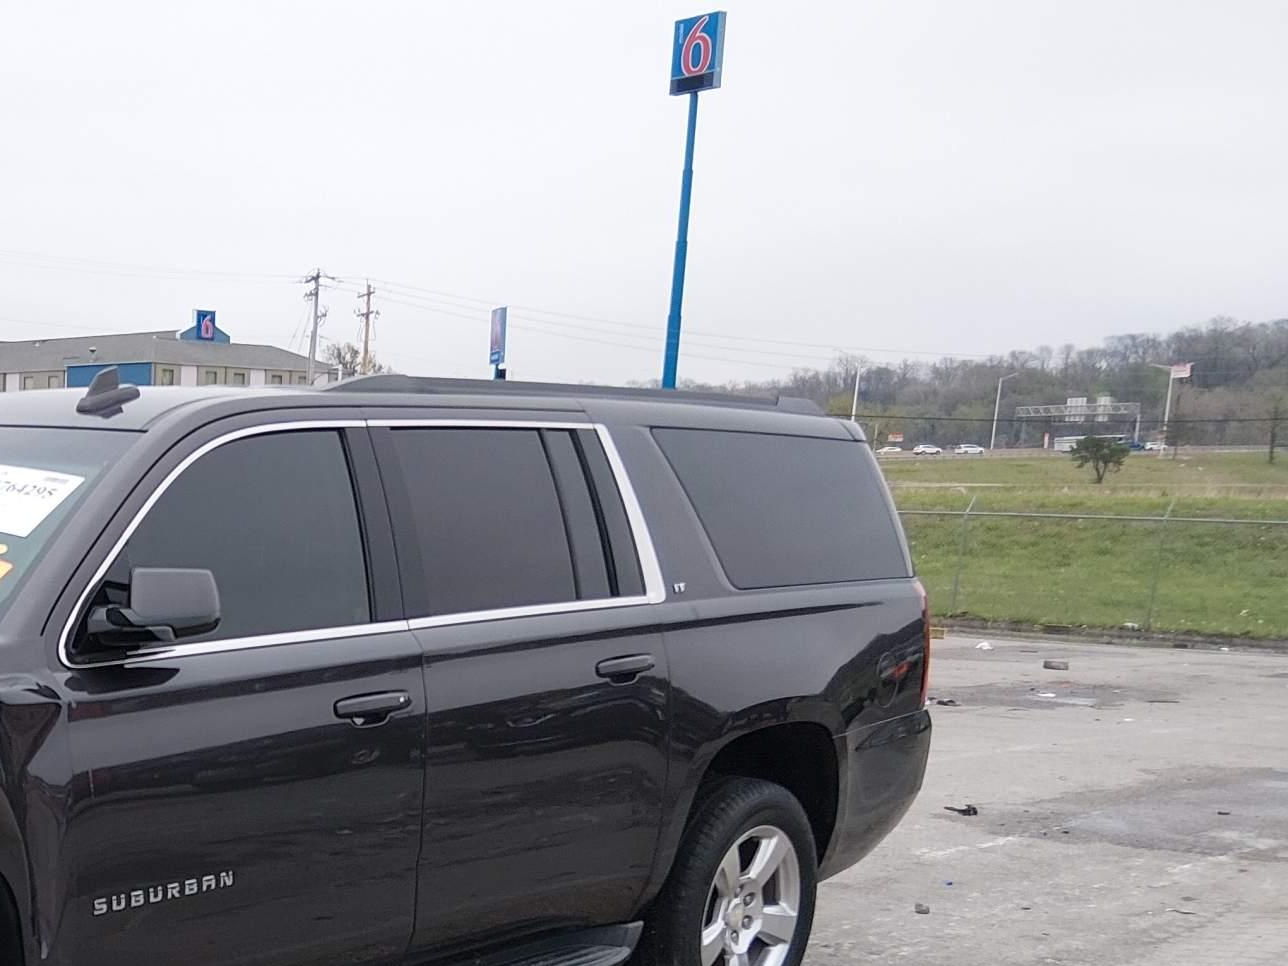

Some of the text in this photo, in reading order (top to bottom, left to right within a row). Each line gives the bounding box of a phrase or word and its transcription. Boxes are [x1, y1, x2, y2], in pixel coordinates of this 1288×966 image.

[680, 15, 712, 77] 6
[201, 314, 214, 339] 6
[92, 870, 234, 916] SUBURBAN
